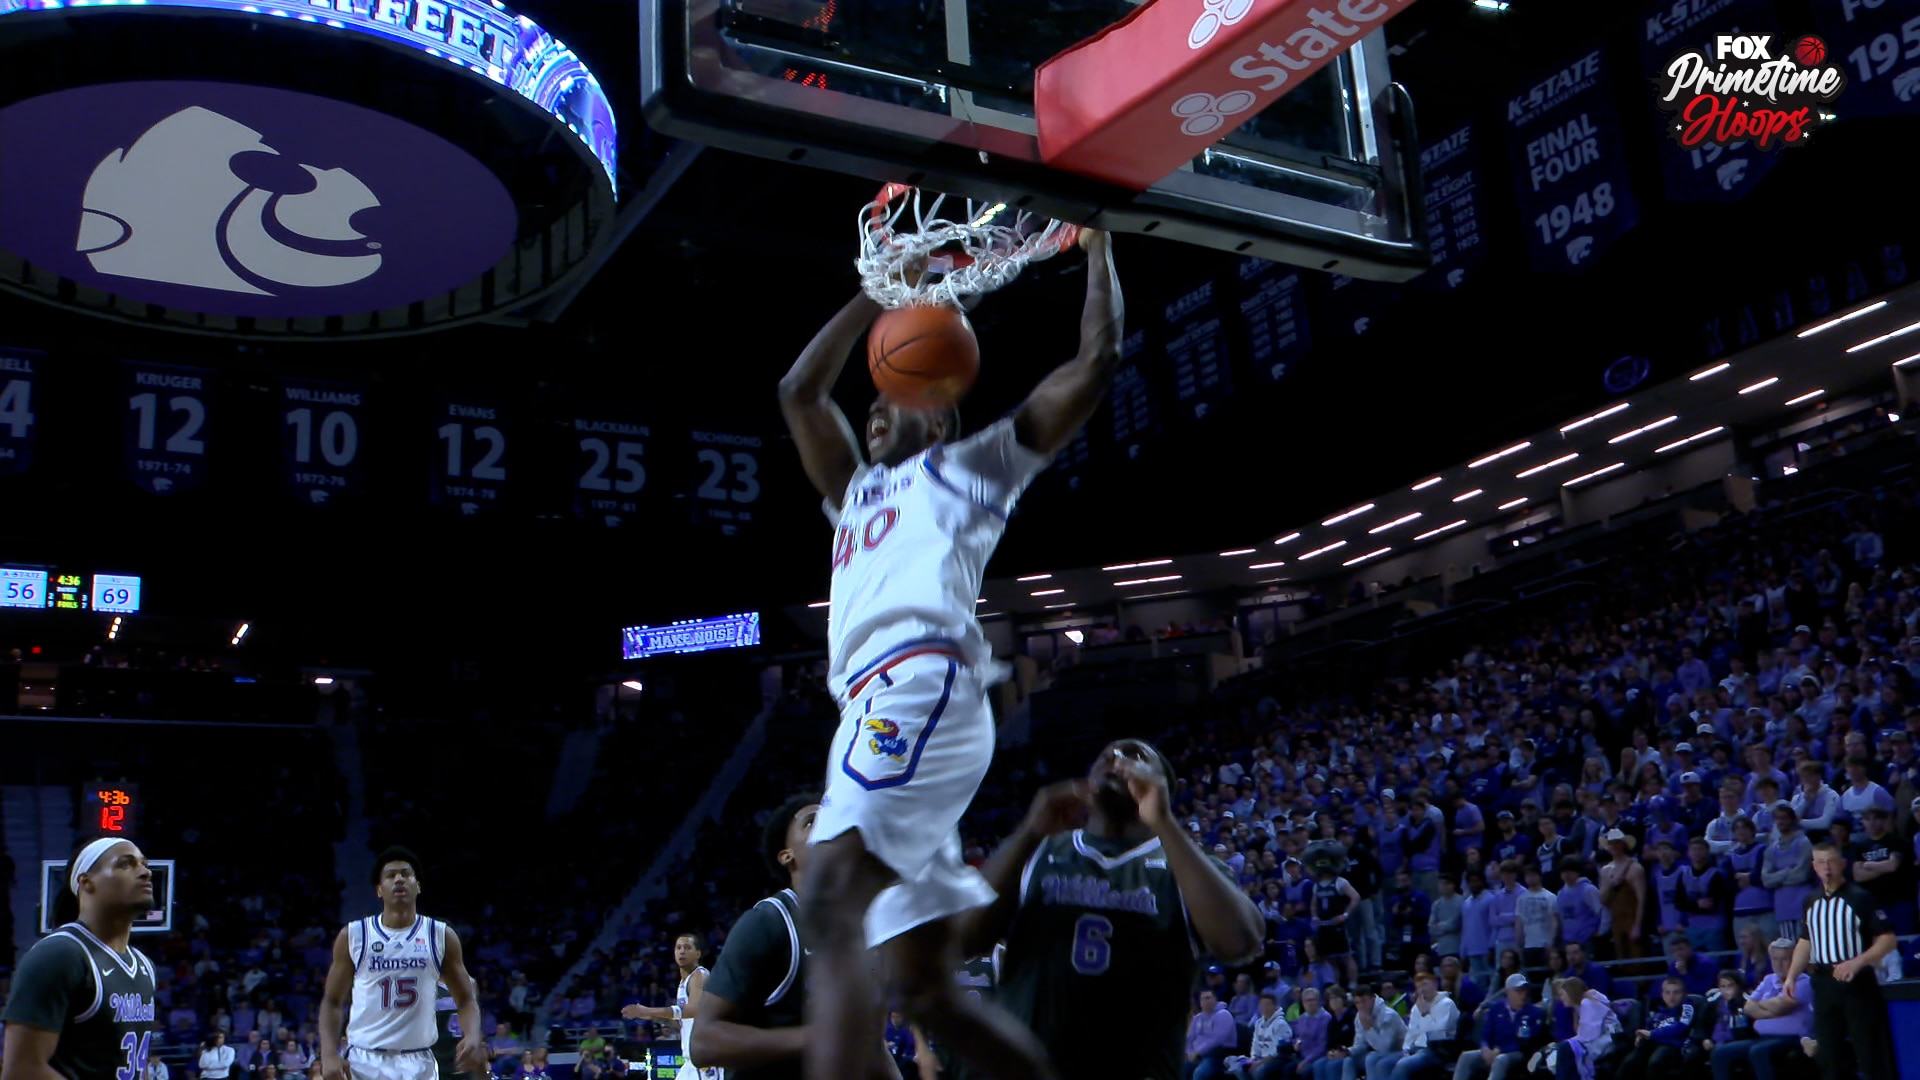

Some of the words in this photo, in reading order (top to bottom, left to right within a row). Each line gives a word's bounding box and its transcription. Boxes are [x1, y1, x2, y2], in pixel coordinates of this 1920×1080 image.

[1229, 0, 1389, 91] State
[1508, 50, 1600, 122] K-STATE
[1526, 113, 1597, 167] FINAL
[1530, 137, 1599, 192] FOUR
[1534, 181, 1615, 245] 1948
[136, 371, 203, 390] KRUGER
[285, 387, 361, 406] WILLIAMS
[129, 392, 206, 455] 12
[448, 403, 496, 420] EVANS
[574, 418, 651, 437] BLACKMAN
[286, 408, 358, 467] 10
[437, 422, 507, 481] 12
[691, 430, 763, 448] RICHMOND
[137, 459, 192, 475] 1971-74
[578, 437, 647, 494] 25
[696, 448, 761, 504] 23
[832, 507, 900, 573] 40
[7, 582, 35, 600] 56
[57, 575, 81, 586] 4:36
[103, 588, 129, 605] 69
[650, 633, 691, 648] MAKE
[695, 628, 735, 643] NOISE
[99, 790, 130, 805] 4:36
[102, 805, 124, 831] 12
[1070, 912, 1114, 976] 6
[369, 955, 427, 972] Kansas
[379, 976, 419, 1010] 15
[115, 1030, 152, 1080] 34
